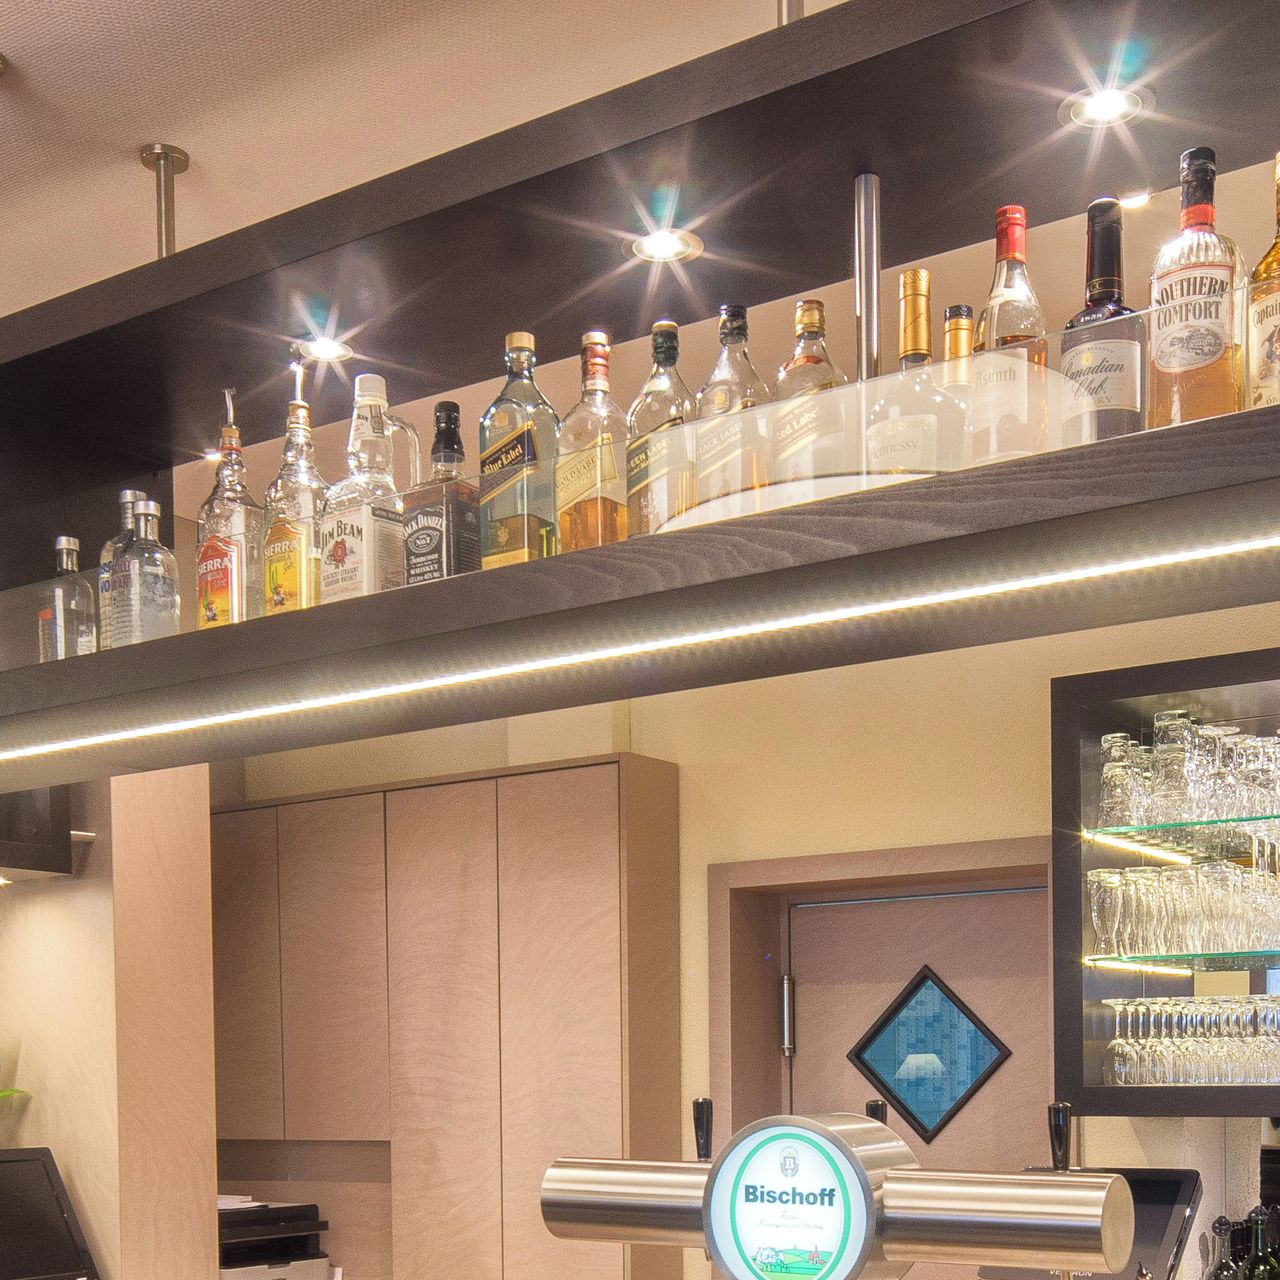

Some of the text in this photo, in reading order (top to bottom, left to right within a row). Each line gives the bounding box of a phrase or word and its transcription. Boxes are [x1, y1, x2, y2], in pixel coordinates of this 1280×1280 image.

[1154, 275, 1229, 307] SOUTHERN
[1156, 300, 1222, 331] COMFORT
[975, 366, 1016, 390] Asbach
[1064, 357, 1125, 382] Canadian
[502, 444, 524, 467] Label
[870, 438, 920, 461] Hennessy
[321, 520, 363, 555] JIM BEAM
[265, 540, 298, 559] SIERRA
[199, 557, 232, 576] SIERRA
[744, 1184, 836, 1207] Bischoff
